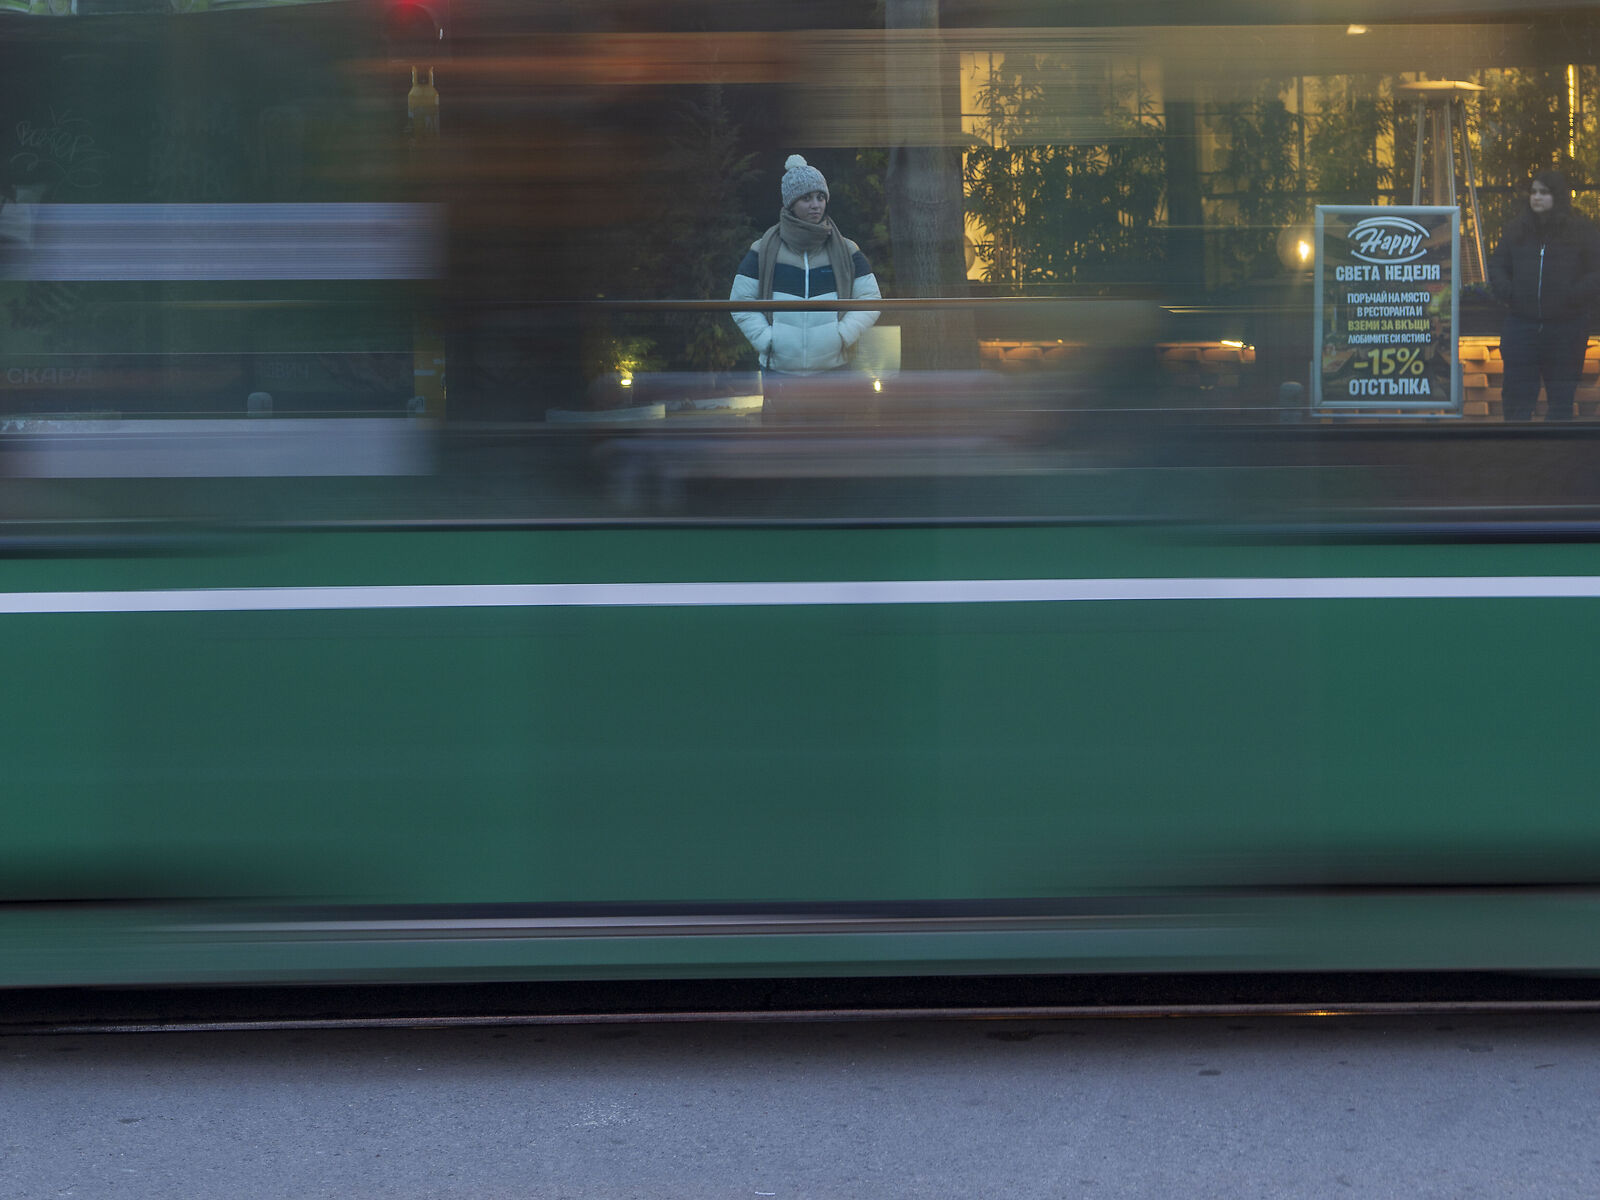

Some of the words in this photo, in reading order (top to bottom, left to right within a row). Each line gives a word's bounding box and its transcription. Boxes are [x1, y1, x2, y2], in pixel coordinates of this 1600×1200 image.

[1355, 227, 1423, 255] Happy
[1335, 265, 1380, 281] СВЕТА
[1385, 264, 1441, 282] НЕДЕЛЯ
[1347, 290, 1388, 304] ПОРЪЧАЙ
[1388, 292, 1400, 303] НА
[1400, 291, 1430, 303] МЯСТО
[1357, 307, 1363, 317] В
[1363, 306, 1416, 317] РЕСТОРАНТА
[1416, 305, 1423, 316] И
[1347, 319, 1380, 331] ВЗЕМИ
[1381, 319, 1394, 330] ЗА
[1395, 318, 1430, 332] ВКЪЩИ
[1347, 334, 1389, 345] ЛЮБИМИТЕ
[1390, 334, 1400, 343] СИ
[1401, 333, 1425, 343] ЯСТИЯ
[1425, 333, 1431, 343] С
[1353, 347, 1424, 375] -15%
[6, 367, 94, 384] СКАРА
[1348, 378, 1431, 396] ОТСТЪПКА
